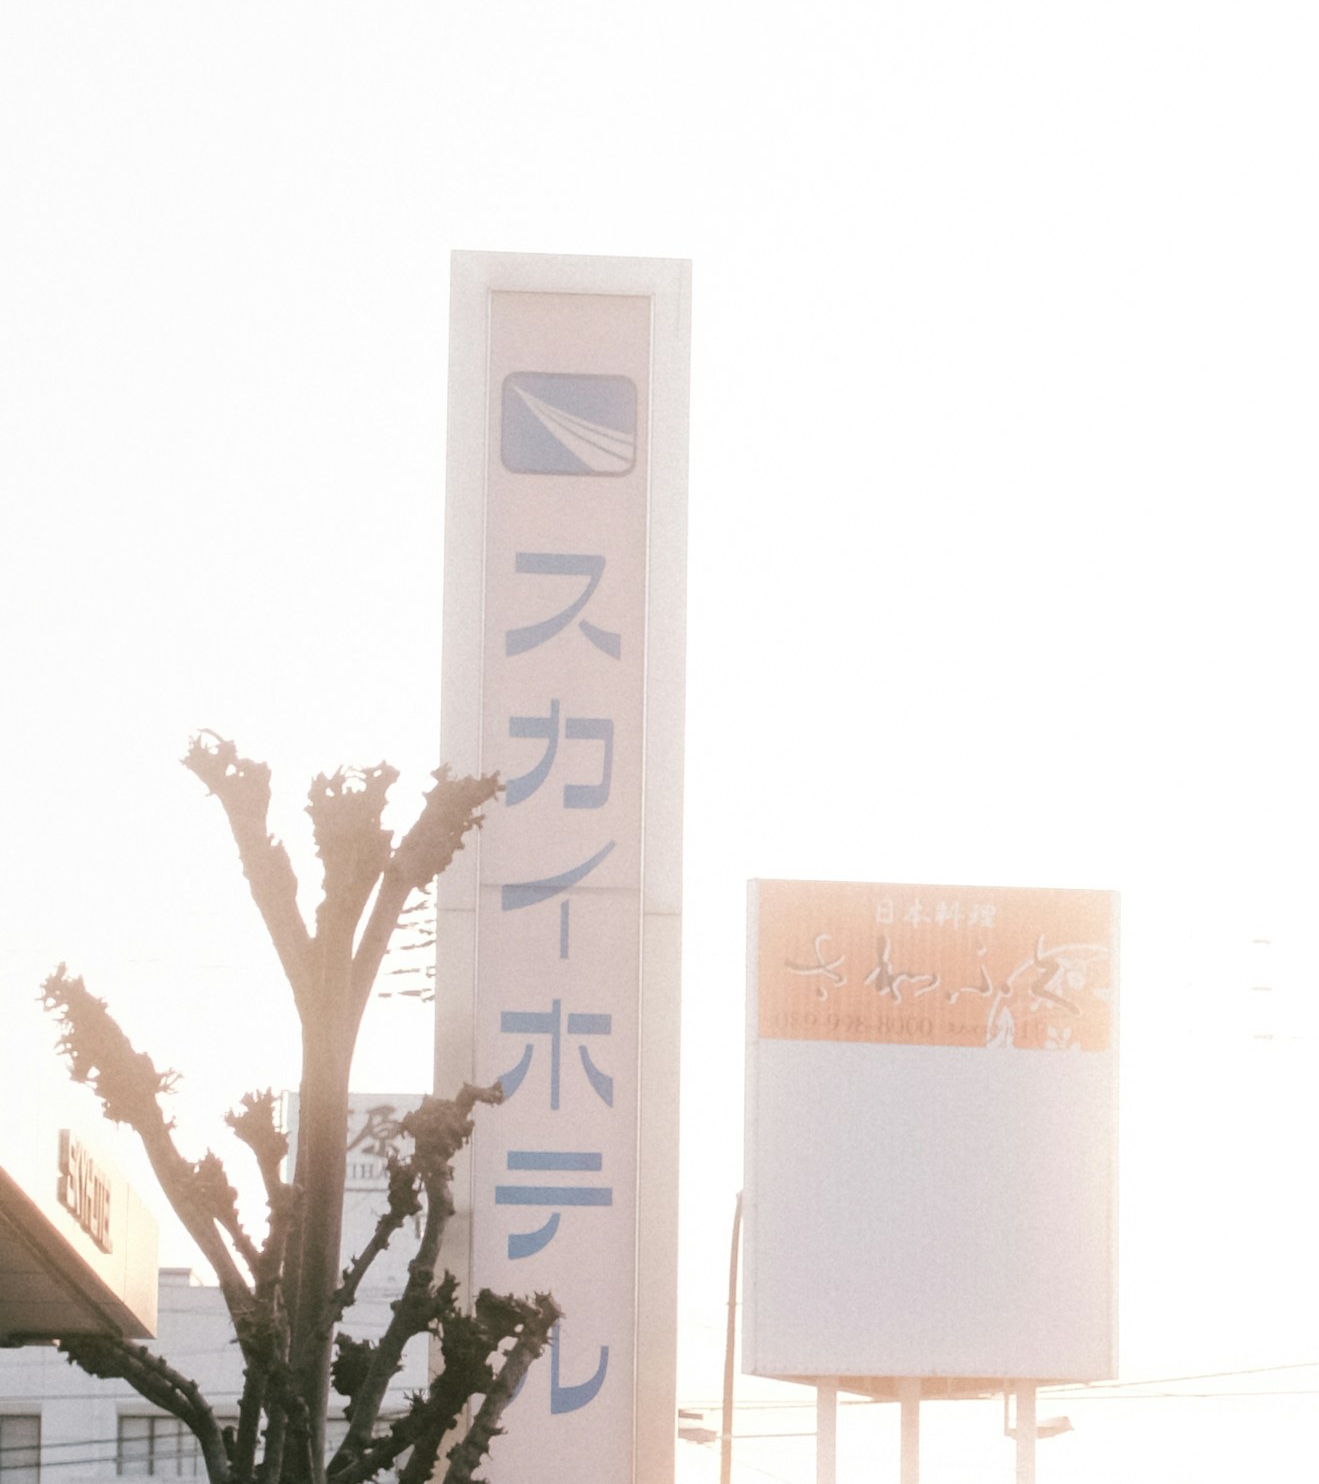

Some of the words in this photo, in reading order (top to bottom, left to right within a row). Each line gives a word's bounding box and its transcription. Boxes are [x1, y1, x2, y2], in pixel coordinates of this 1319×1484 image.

[495, 552, 621, 1414] スカイホテル
[875, 898, 997, 929] 日本料理
